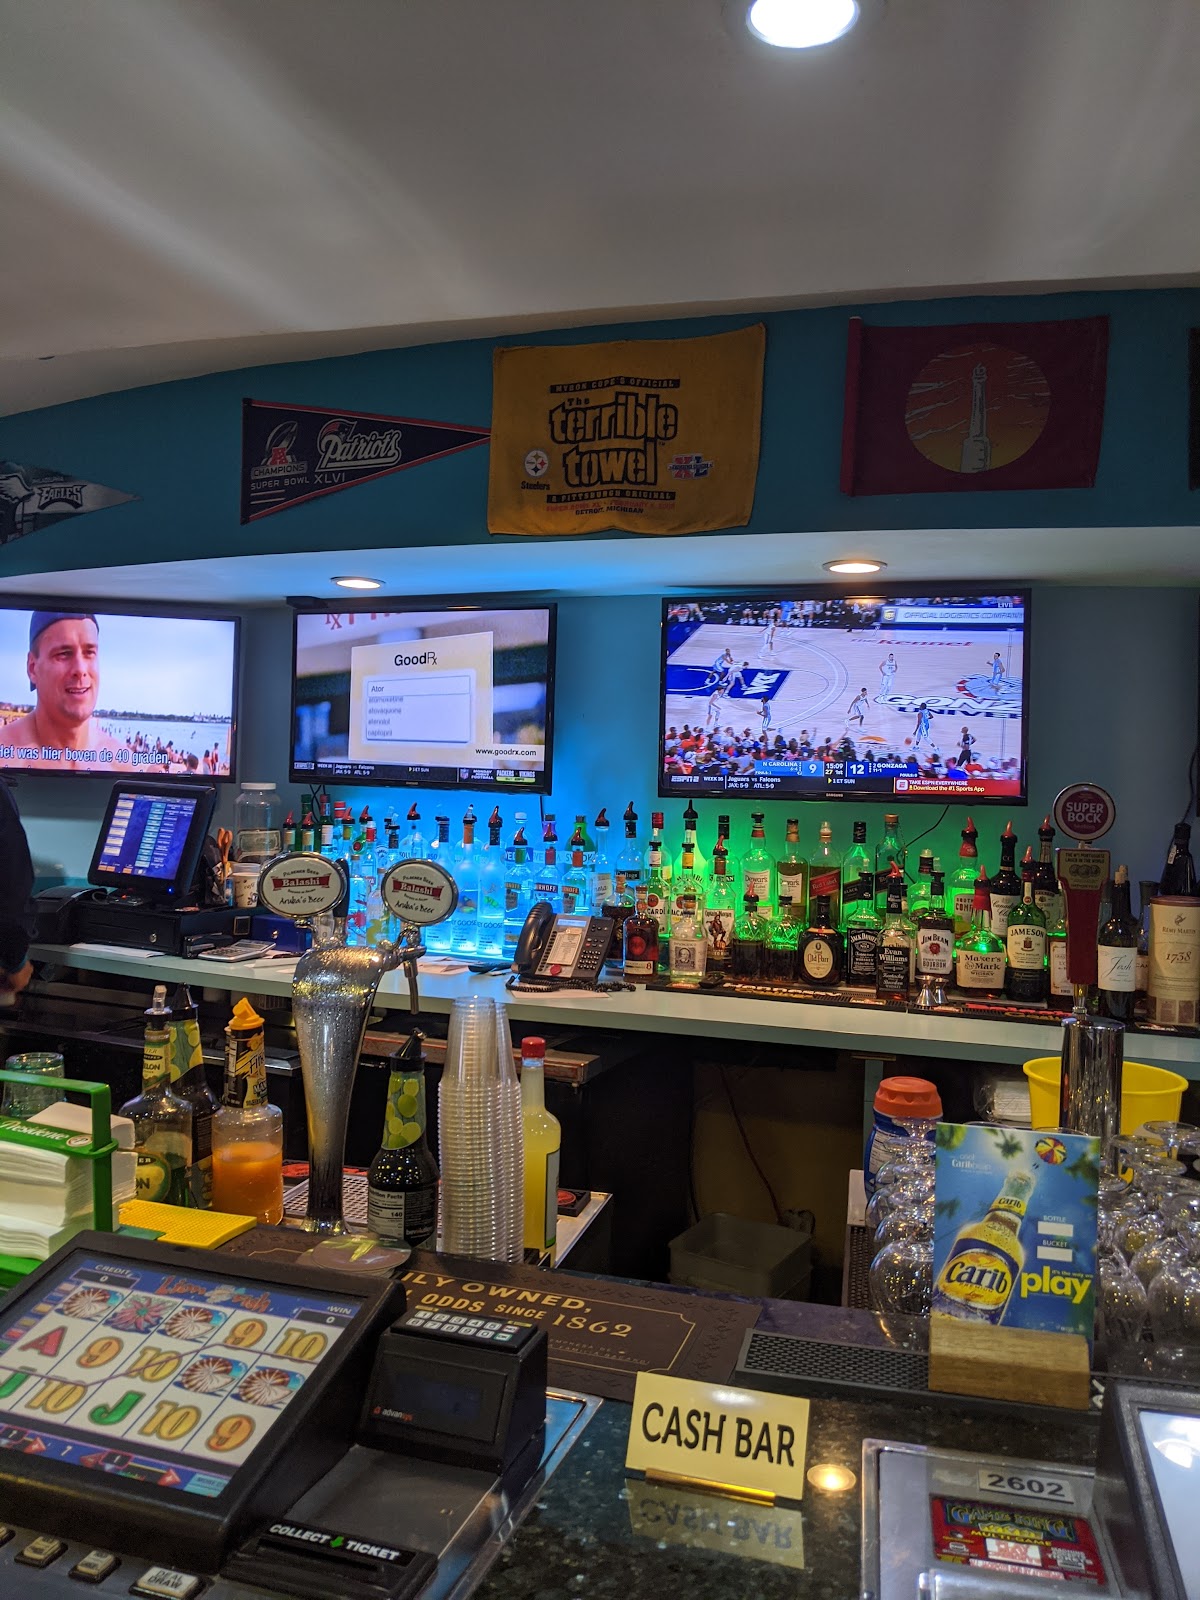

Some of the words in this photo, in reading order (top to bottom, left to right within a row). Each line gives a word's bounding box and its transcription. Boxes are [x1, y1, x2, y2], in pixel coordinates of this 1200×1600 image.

[629, 378, 674, 388] OFFICIAL
[567, 397, 590, 407] The
[549, 391, 679, 445] terrible
[320, 430, 400, 469] Patriots
[253, 463, 305, 477] CHAMPIONS
[562, 439, 658, 488] towel
[250, 481, 280, 491] SUPER
[283, 477, 310, 486] BOWL
[314, 472, 346, 484] XLVI
[520, 480, 551, 491] Steelers
[38, 485, 87, 509] EAGLES
[561, 489, 621, 502] PITTSBURGH
[625, 490, 671, 500] ORIGINAL
[903, 611, 938, 619] OFFICIAL
[940, 611, 979, 619] LOGISTICS
[394, 651, 438, 667] GoodRx
[371, 685, 384, 693] Ator
[18, 747, 39, 760] was
[41, 746, 63, 760] hier
[65, 747, 97, 762] boven
[99, 748, 113, 763] de
[115, 749, 130, 763] 40
[132, 750, 172, 766] graden.
[475, 748, 537, 756] www.goodrx.com
[808, 764, 817, 774] 9
[849, 764, 865, 775] 12
[1065, 801, 1104, 814] SUPER
[1067, 812, 1102, 823] BOCK
[281, 877, 321, 887] Balashi
[400, 883, 433, 896] Balashi
[279, 895, 307, 905] Aruba's
[308, 895, 325, 903] Beer
[394, 900, 419, 910] Aruba's
[419, 904, 435, 914] Beer
[483, 921, 503, 929] GOOSE
[850, 932, 863, 943] JACK
[1010, 928, 1045, 938] JAMESON
[920, 935, 932, 945] JIM
[932, 934, 949, 946] BEAM
[884, 947, 903, 955] Evan
[1165, 951, 1192, 964] 1738
[807, 954, 817, 963] Old
[817, 954, 830, 964] Parr
[879, 954, 908, 963] Williams
[922, 960, 947, 968] BOURBON
[964, 954, 1002, 963] Maker's
[975, 962, 1001, 970] Mark
[998, 1197, 1022, 1209] Carib
[1043, 1215, 1067, 1223] BOTTLE
[1042, 1239, 1068, 1248] BUCKET
[99, 1274, 108, 1283] 0
[945, 1261, 1008, 1294] Carib
[1020, 1265, 1092, 1305] play
[461, 1281, 593, 1314] OWNED,
[328, 1305, 351, 1315] WIN
[421, 1292, 485, 1313] ODDS
[494, 1303, 547, 1321] SINCE
[552, 1314, 633, 1338] 1862
[325, 1315, 335, 1325] 0
[222, 1318, 268, 1350] 9
[17, 1325, 68, 1358] A
[272, 1327, 328, 1361] 10
[76, 1336, 124, 1369] 9
[126, 1346, 184, 1383] 10
[25, 1375, 89, 1414] 10
[88, 1390, 147, 1426] J
[138, 1400, 202, 1441] 10
[205, 1414, 256, 1452] 9
[641, 1401, 727, 1454] CASH
[734, 1416, 795, 1467] BAR
[986, 1473, 1066, 1498] 2602
[269, 1523, 331, 1545] COLLECT
[345, 1539, 401, 1562] TICKET
[970, 1529, 1053, 1547] MULTI-GAME
[156, 1570, 183, 1581] DEAL
[148, 1576, 183, 1589] DRAW
